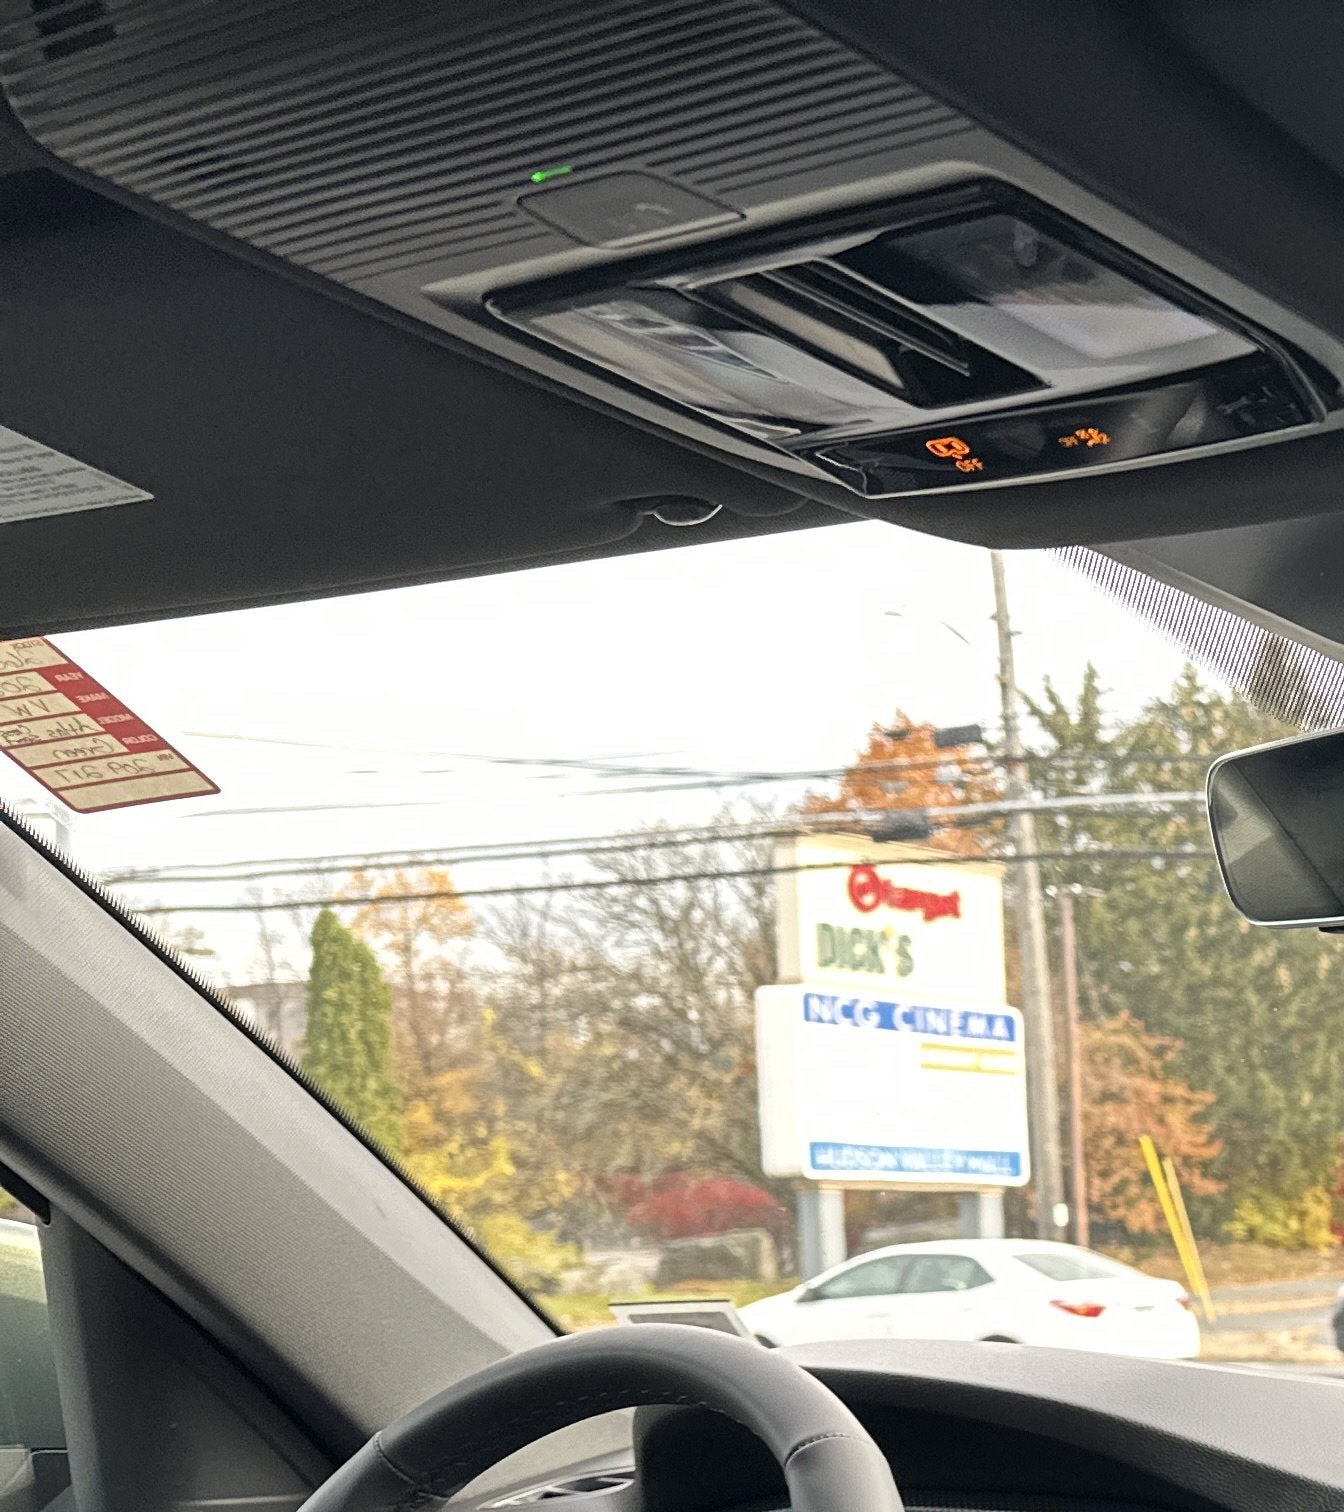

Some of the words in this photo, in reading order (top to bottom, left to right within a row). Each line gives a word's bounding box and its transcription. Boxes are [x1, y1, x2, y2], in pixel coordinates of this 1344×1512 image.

[816, 922, 915, 977] DICK'S
[807, 994, 882, 1029] NCG
[893, 1003, 1011, 1040] CINEMA
